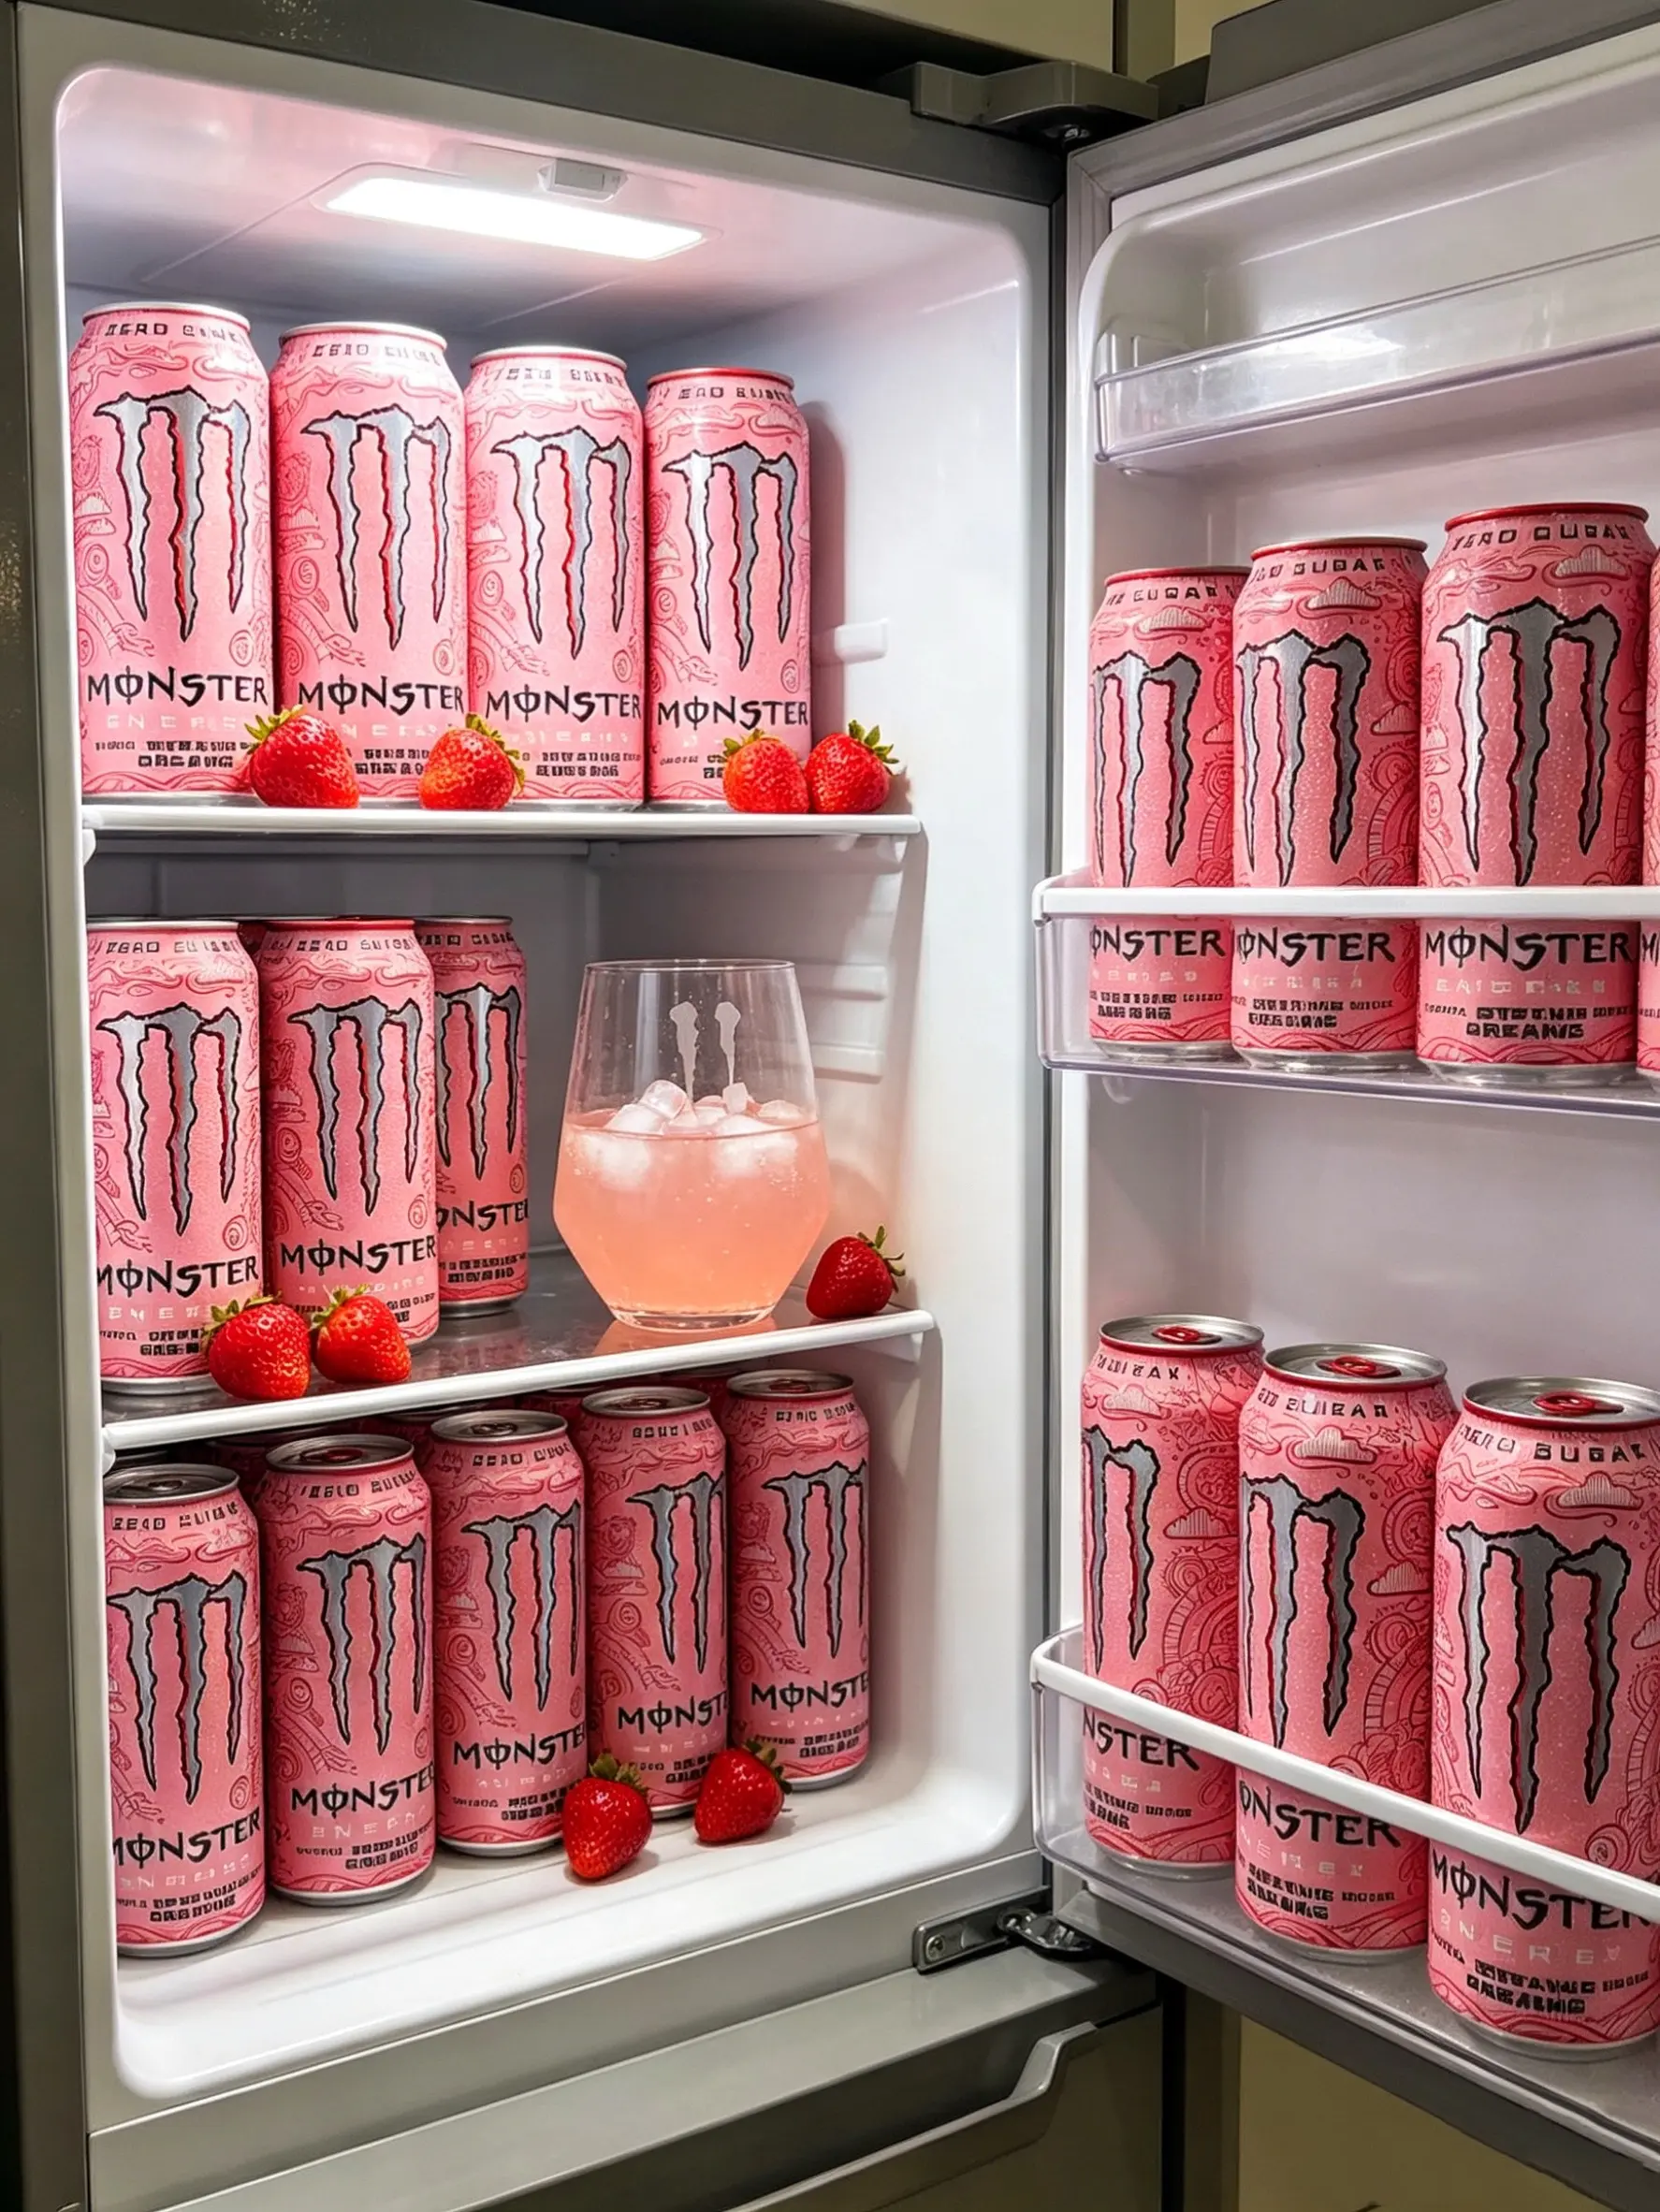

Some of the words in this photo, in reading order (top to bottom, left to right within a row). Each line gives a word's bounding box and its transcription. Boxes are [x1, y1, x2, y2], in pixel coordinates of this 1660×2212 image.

[87, 665, 269, 707] MONSTER
[299, 674, 464, 716] MONSTER
[486, 684, 642, 723] MONSTER
[658, 695, 809, 732] MONSTER
[1090, 924, 1227, 962] ONSTER
[1236, 925, 1396, 968] ONSTER
[1425, 924, 1635, 972] MONSTER
[436, 1198, 530, 1234] ONSTE
[281, 1234, 437, 1277] MONSTER
[97, 1256, 259, 1299] MONSTER
[618, 1689, 730, 1736] MONST
[751, 1673, 870, 1713] MONSTE
[453, 1721, 587, 1770] MONSTE
[1083, 1707, 1201, 1771] NSTER
[1239, 1780, 1402, 1848] ONSTER
